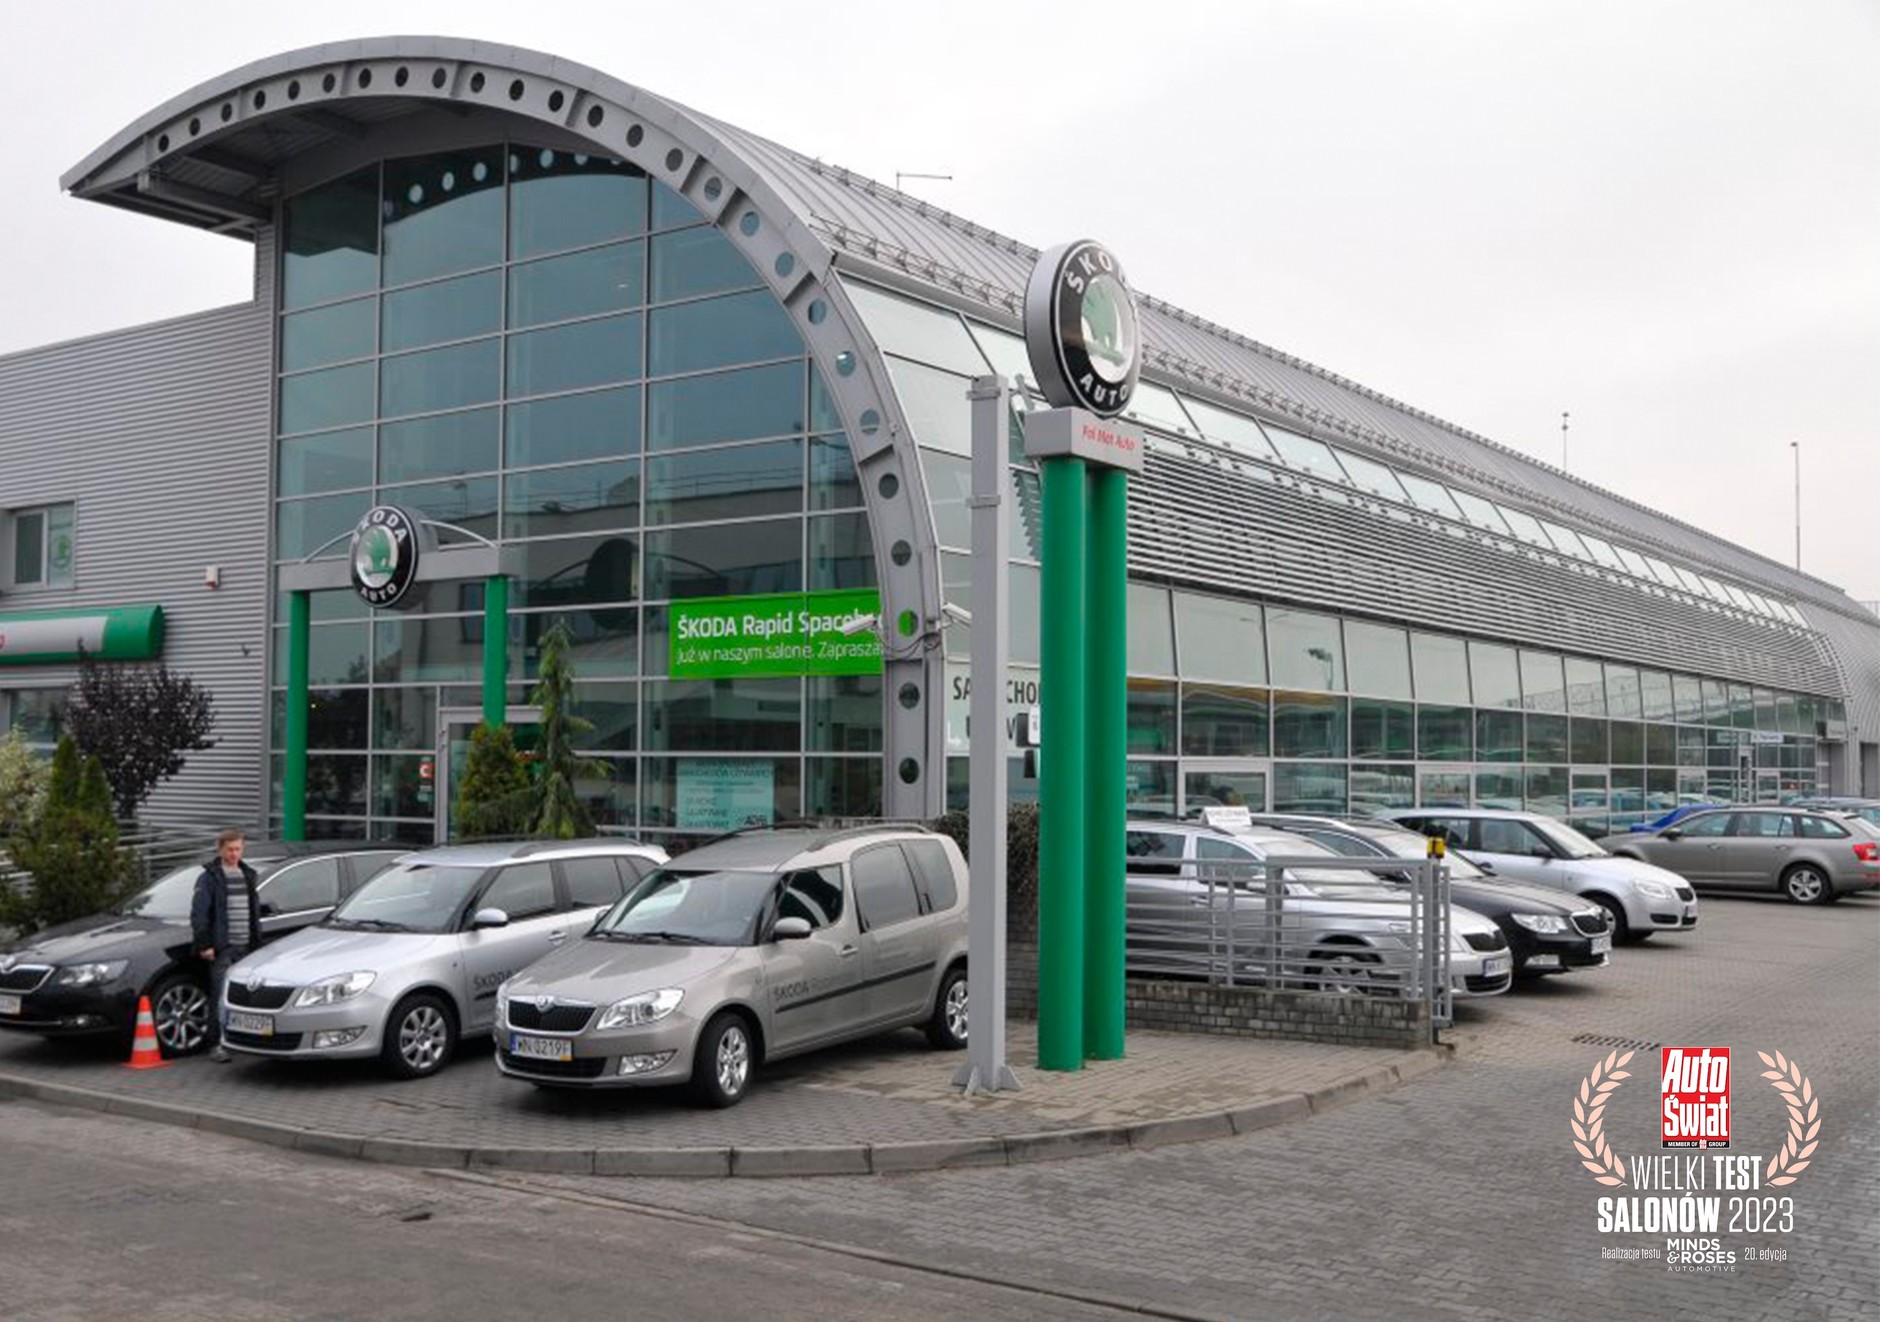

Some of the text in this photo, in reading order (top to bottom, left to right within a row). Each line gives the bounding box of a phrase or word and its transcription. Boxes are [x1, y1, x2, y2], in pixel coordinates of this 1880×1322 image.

[1080, 372, 1130, 407] AUTO
[360, 583, 397, 602] AUTO
[678, 614, 737, 639] ŠKODA
[743, 612, 793, 640] Rapid
[698, 649, 711, 661] w
[713, 647, 762, 664] naszym
[818, 641, 884, 660] Zaprasza
